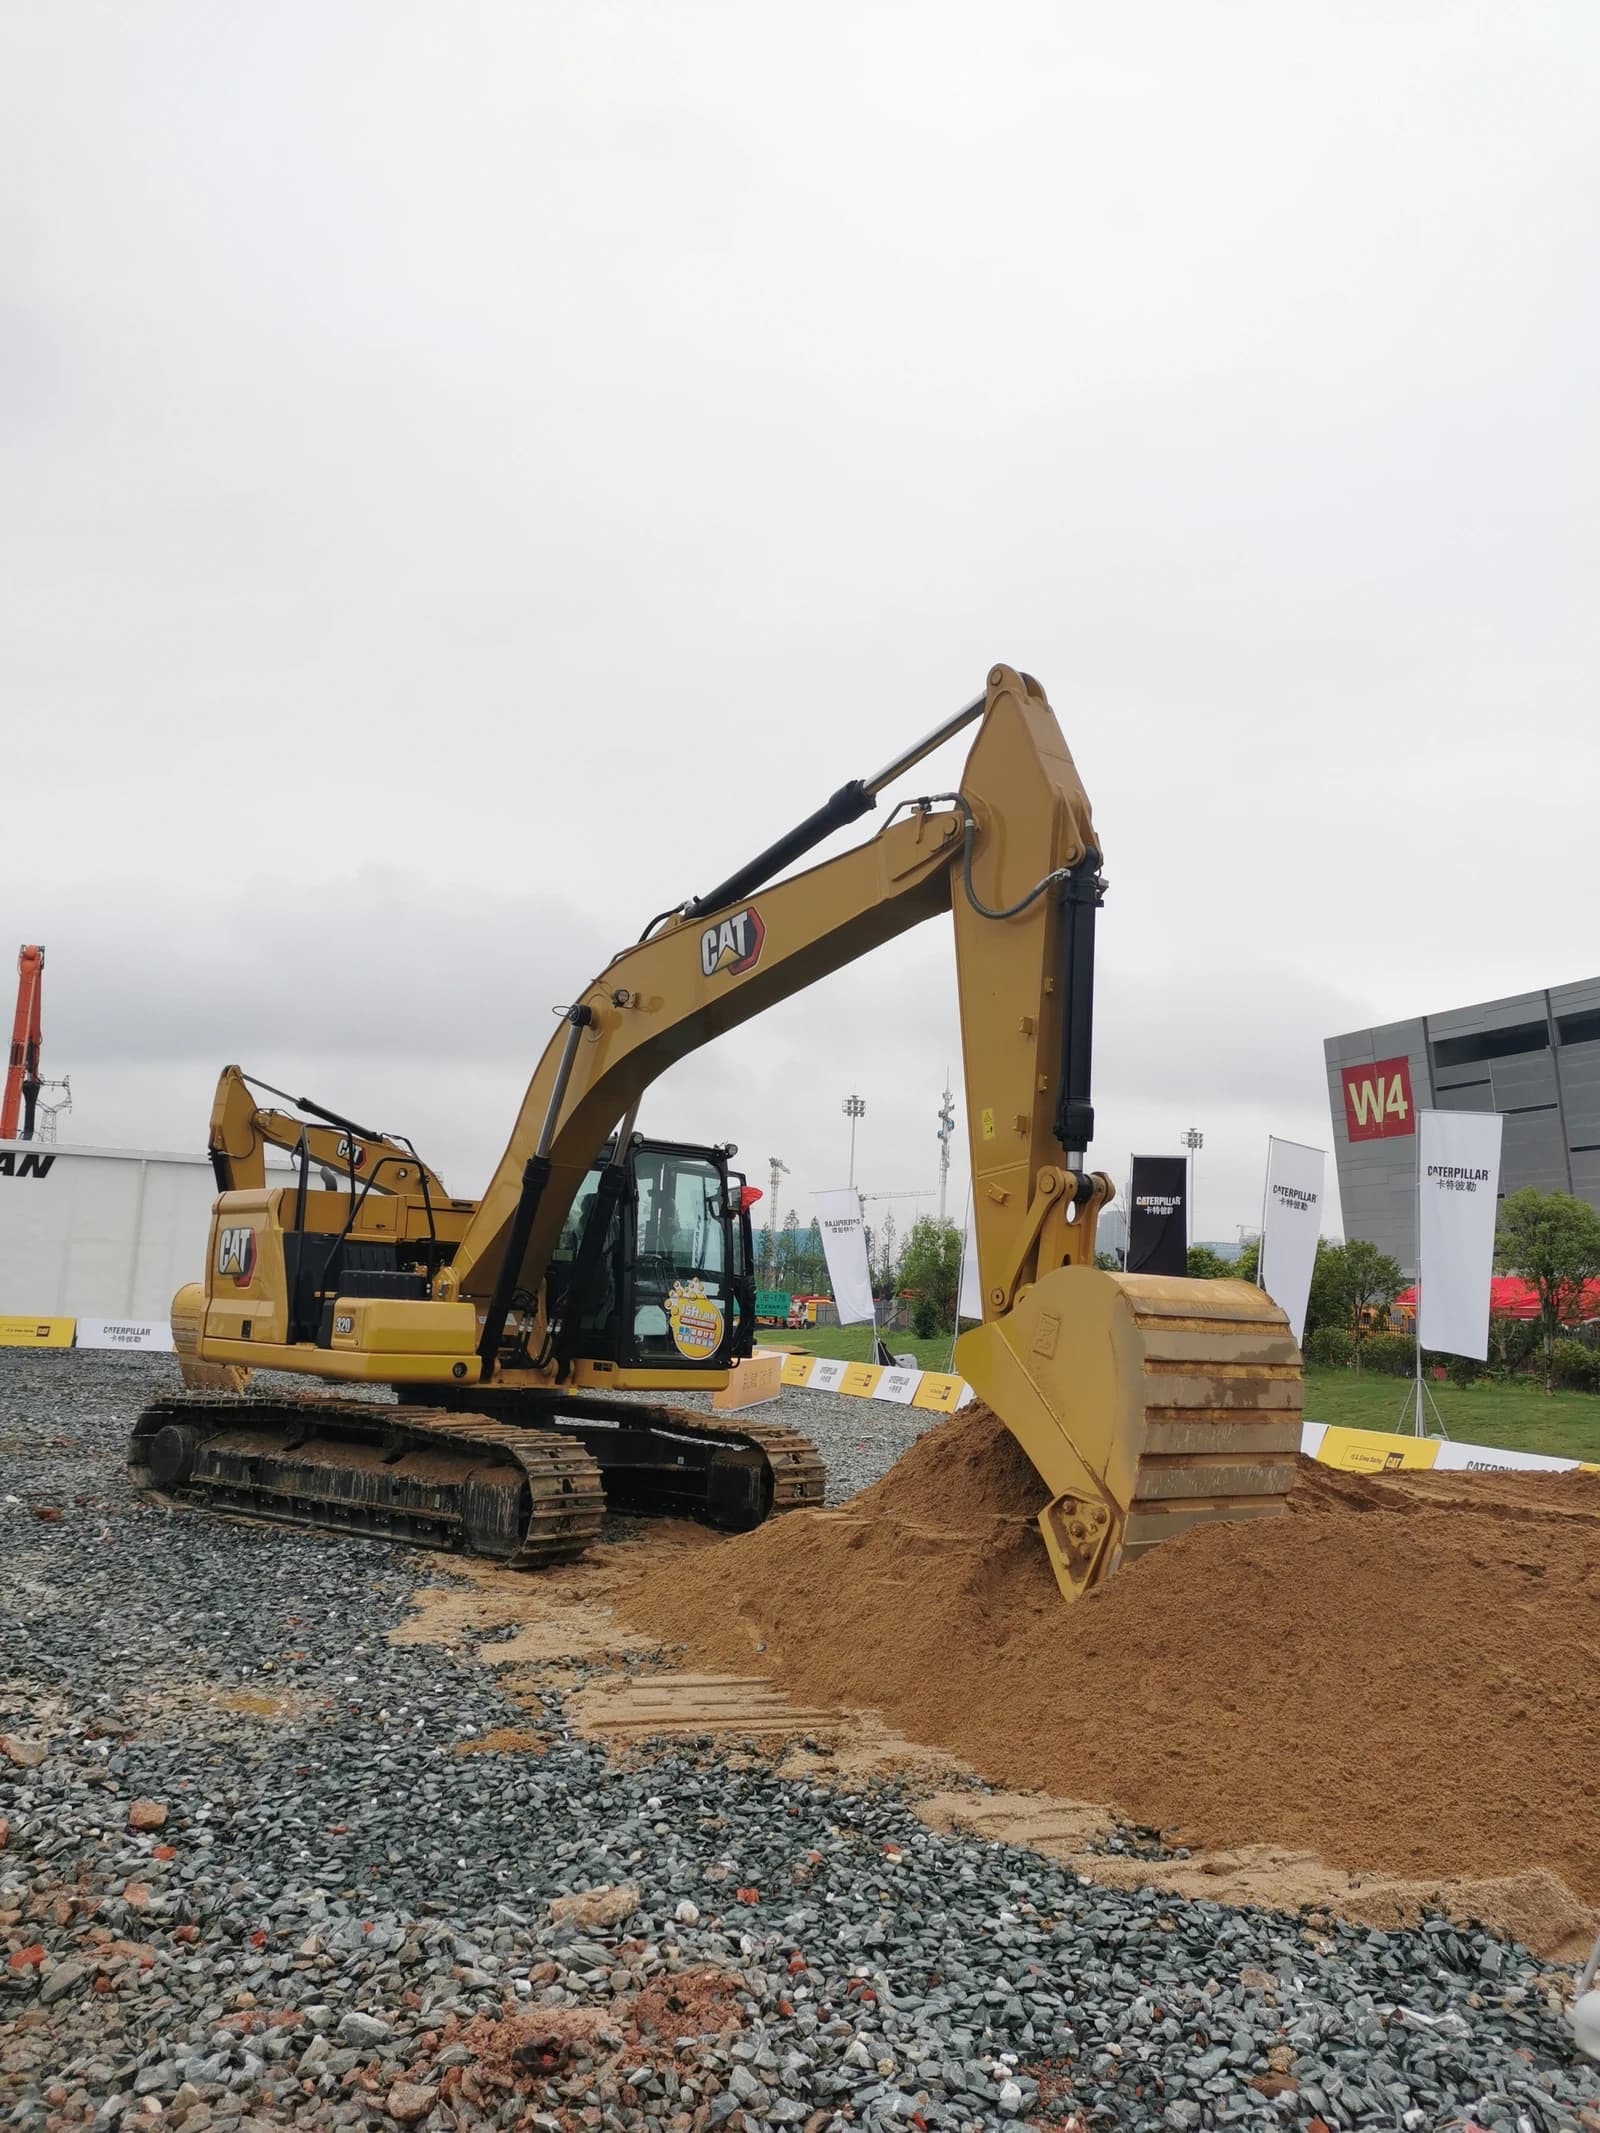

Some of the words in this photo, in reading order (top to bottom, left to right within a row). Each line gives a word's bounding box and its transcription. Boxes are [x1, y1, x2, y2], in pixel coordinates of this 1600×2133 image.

[701, 910, 748, 976] CAT
[1348, 1073, 1408, 1126] W4
[1427, 1165, 1489, 1181] CATERPILLAR
[1272, 1184, 1317, 1204] CATERPILLAR
[1435, 1179, 1477, 1192] 卡特彼勒
[1136, 1196, 1181, 1206] CATERPILLAR
[219, 1229, 251, 1274] CAT
[336, 1317, 352, 1332] 320
